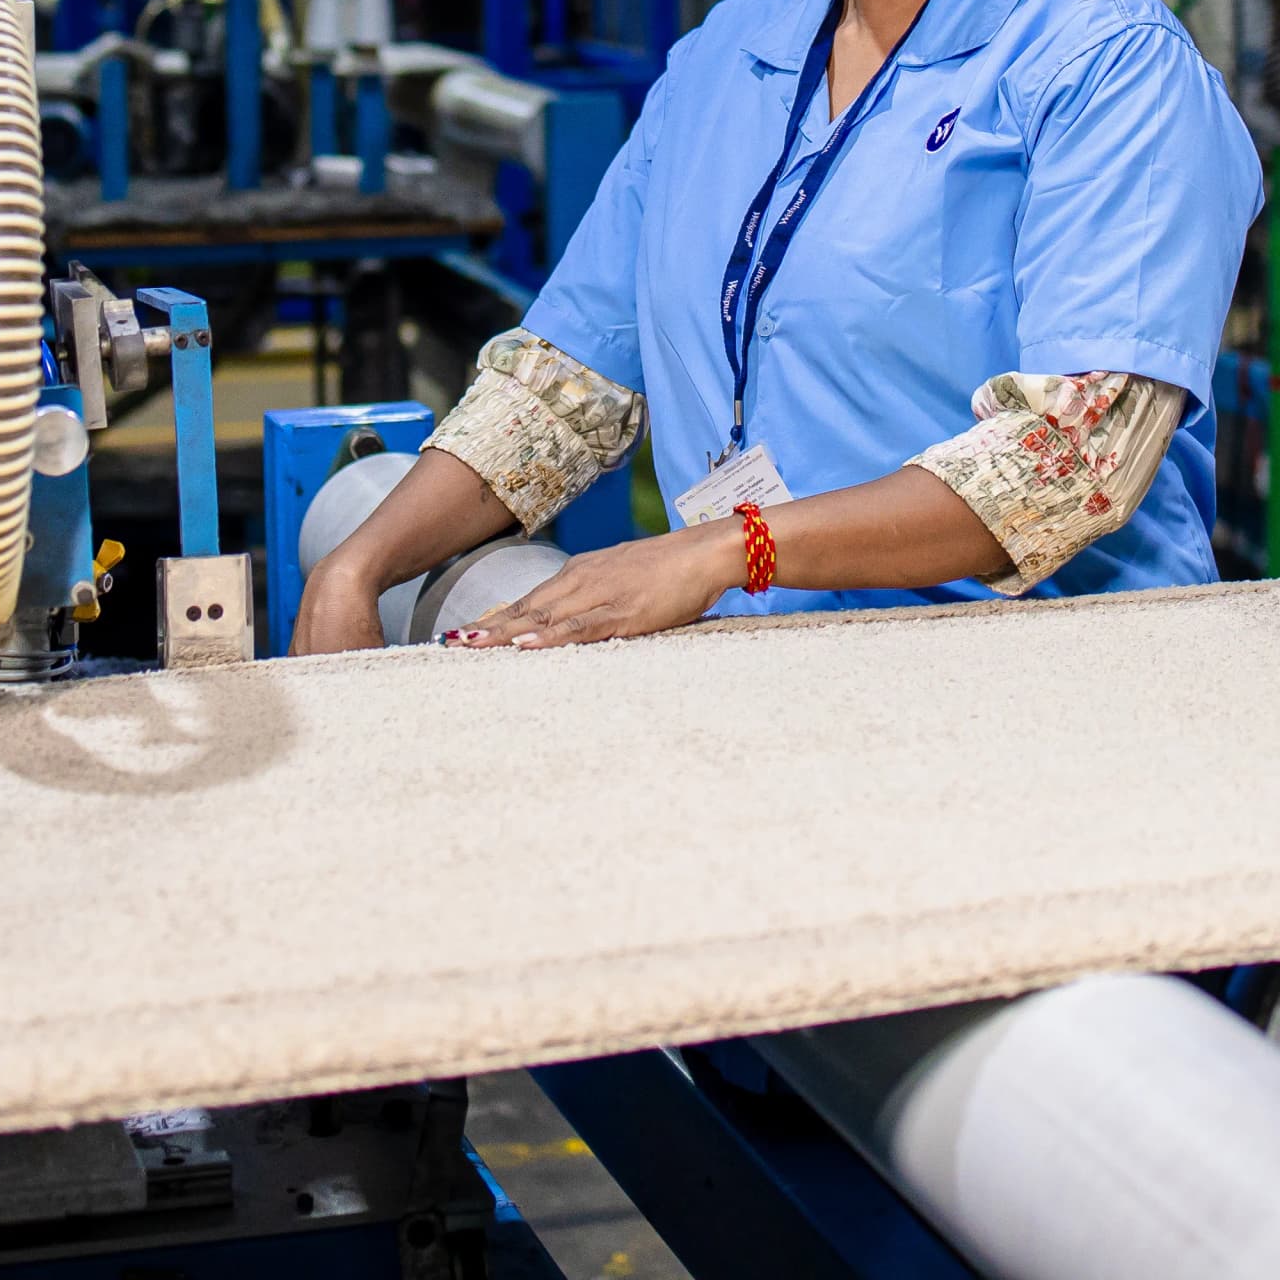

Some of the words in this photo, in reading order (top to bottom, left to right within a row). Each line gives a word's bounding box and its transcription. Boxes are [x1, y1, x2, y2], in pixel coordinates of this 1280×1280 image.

[779, 190, 807, 225] Welspun
[744, 211, 761, 245] Welspun
[722, 279, 739, 319] Welspun
